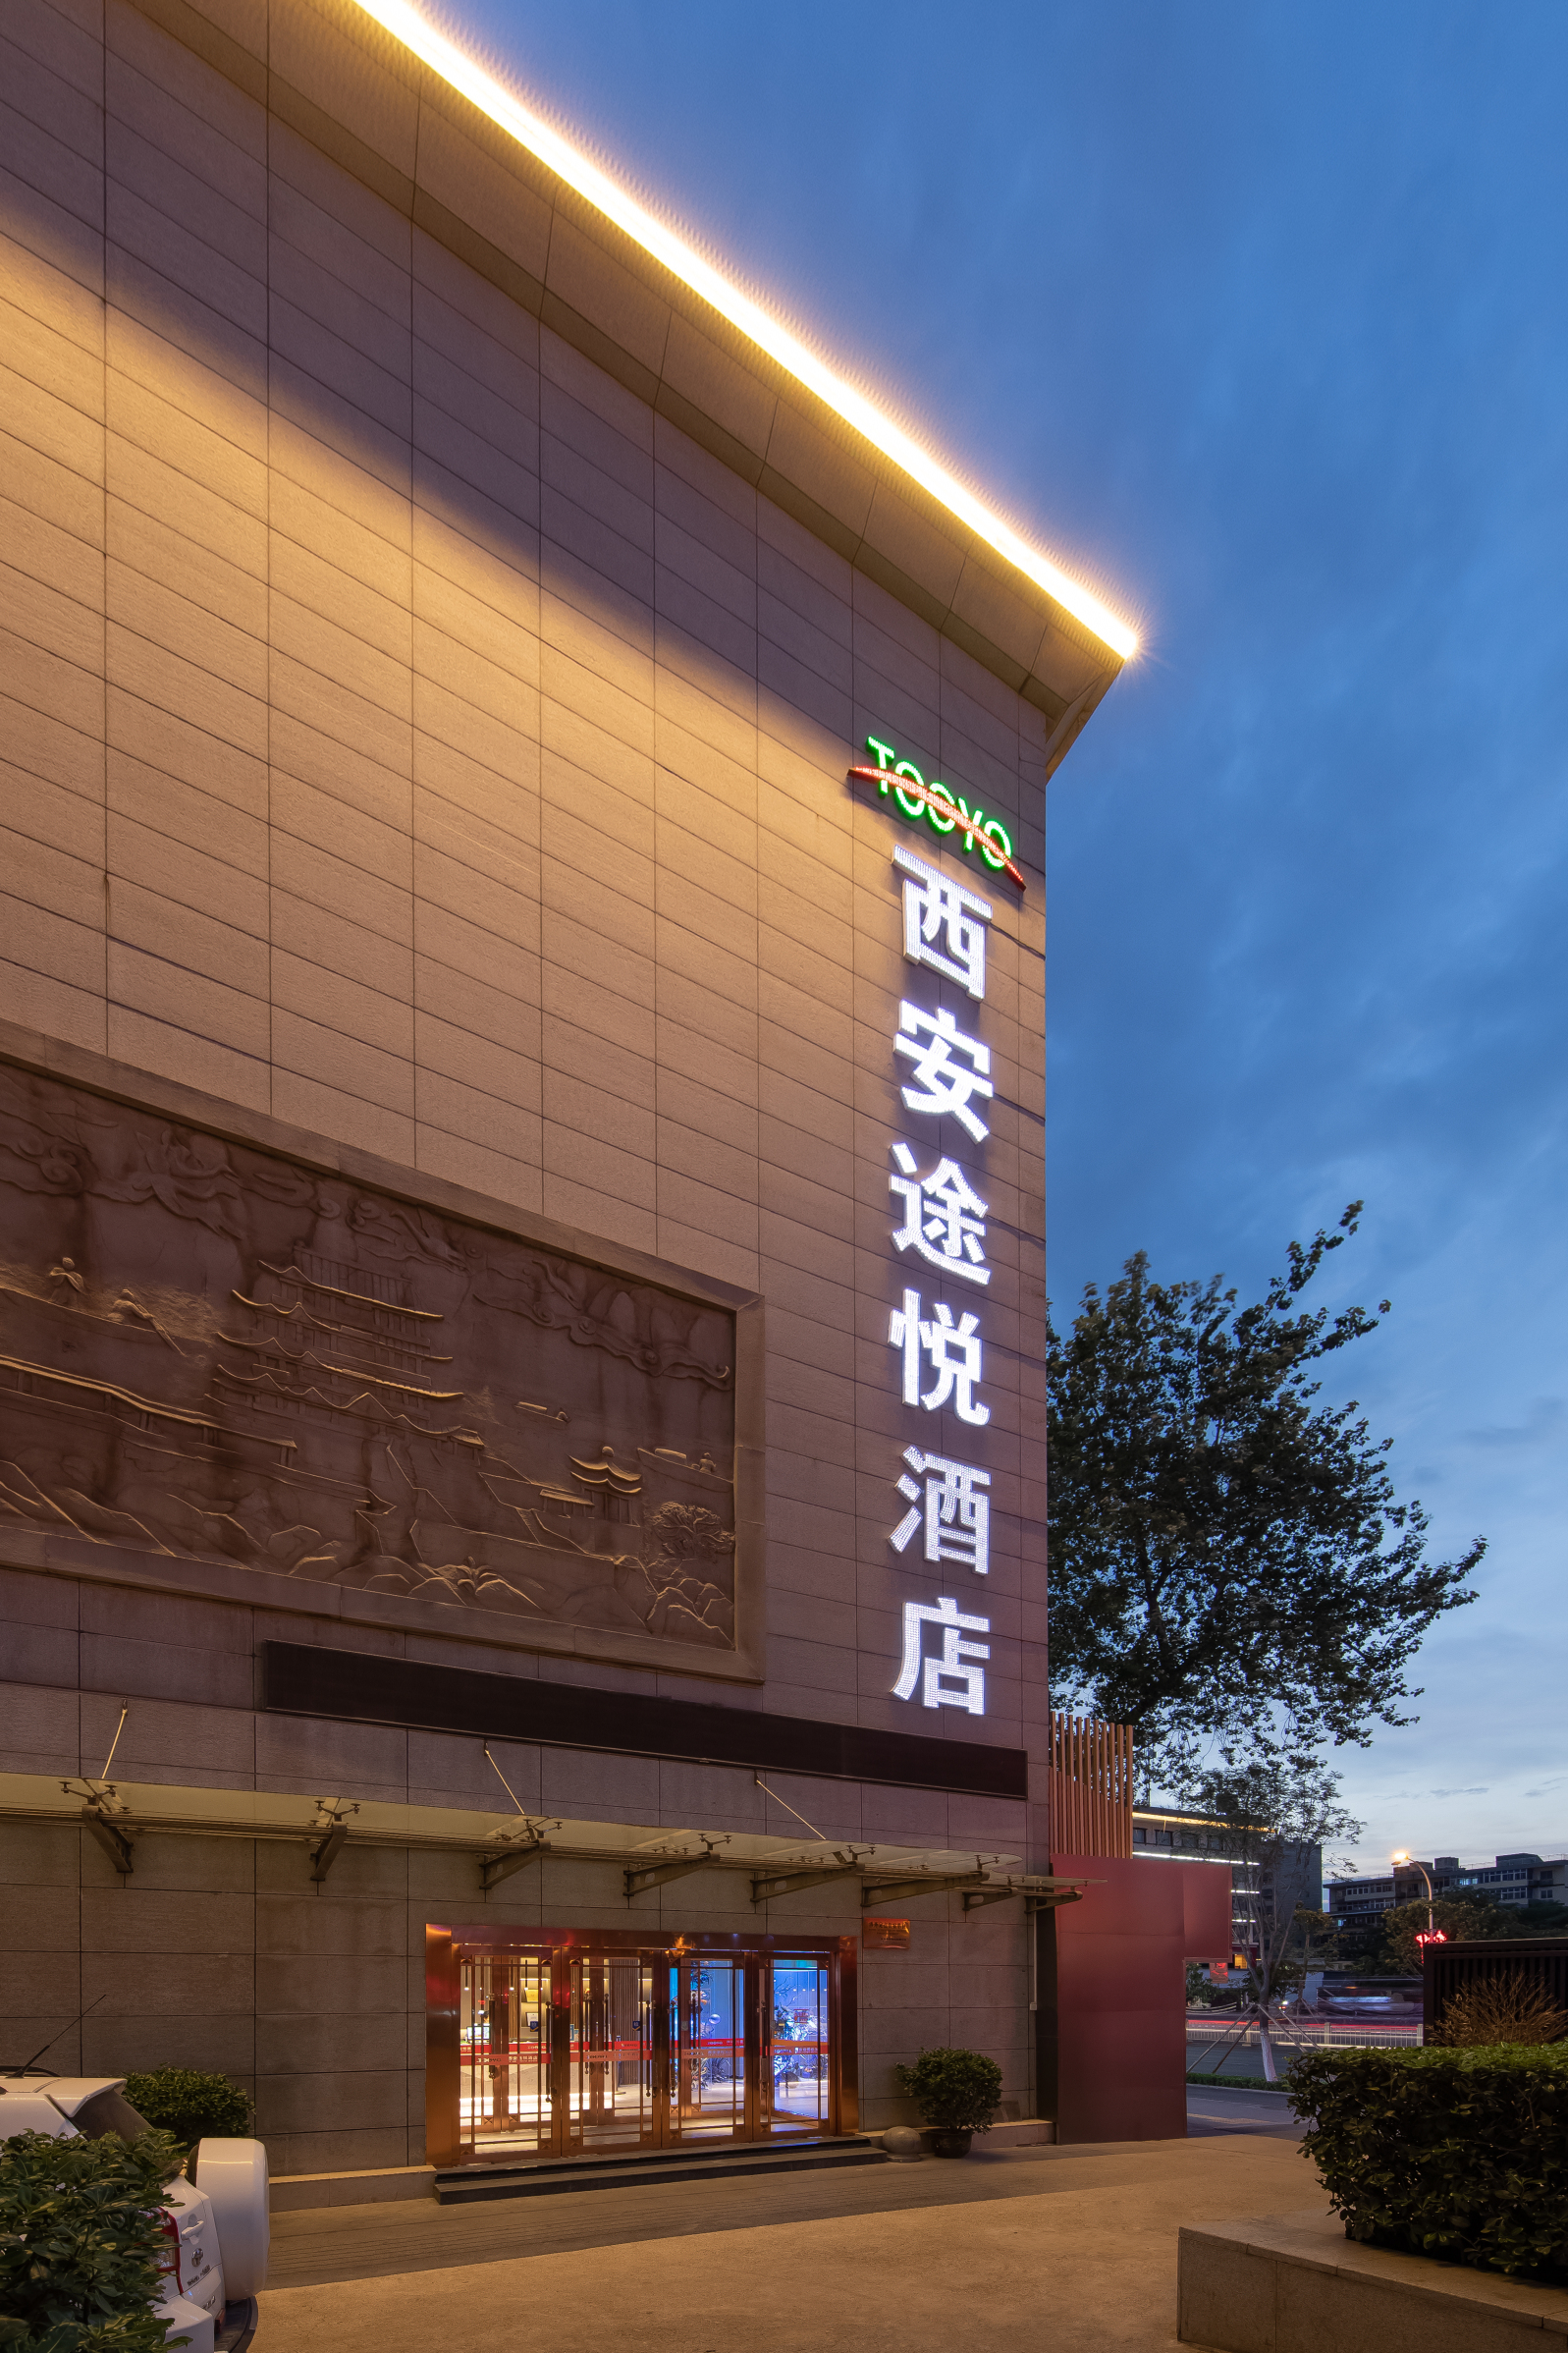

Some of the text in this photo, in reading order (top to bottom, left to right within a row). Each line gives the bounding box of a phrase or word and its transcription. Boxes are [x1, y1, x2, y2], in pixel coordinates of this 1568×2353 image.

[891, 844, 994, 1718] 西安途悦酒店
